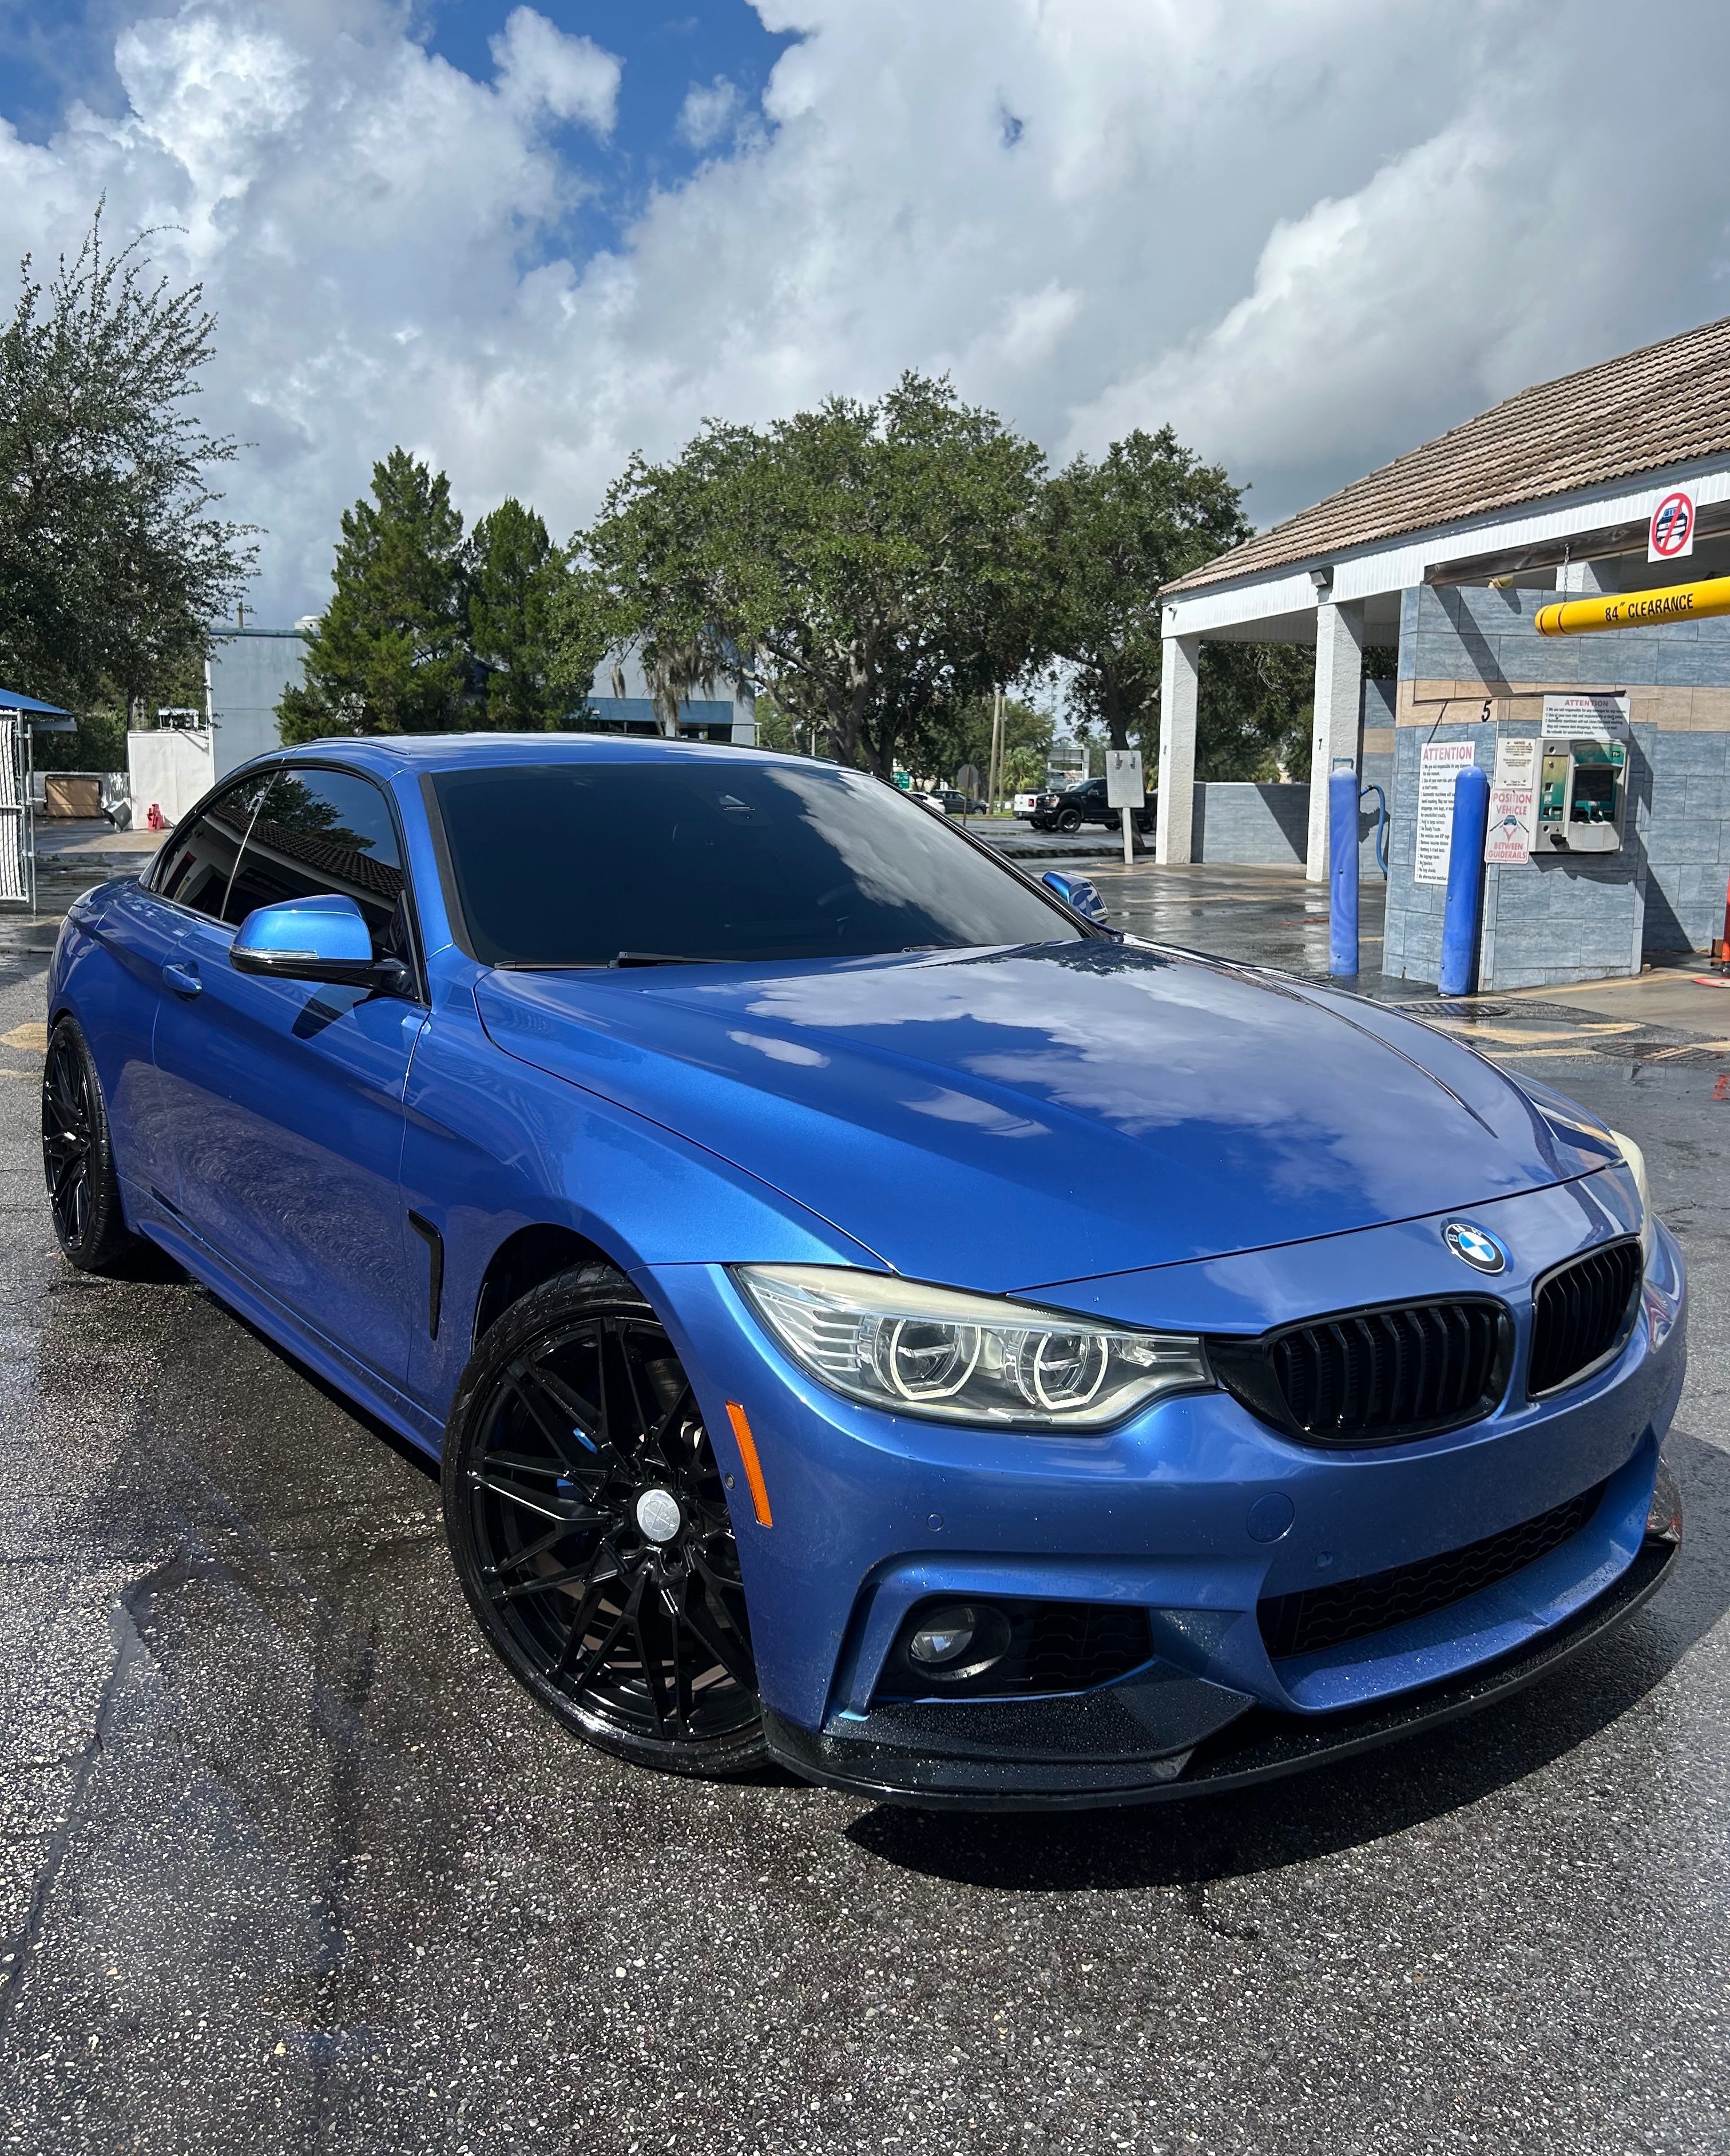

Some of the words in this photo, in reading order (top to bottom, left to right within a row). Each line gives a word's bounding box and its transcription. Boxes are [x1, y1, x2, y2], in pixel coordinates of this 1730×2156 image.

[1605, 601, 1625, 622] 84"
[1628, 593, 1693, 618] CLEARANCE
[1482, 700, 1492, 722] 5
[1423, 746, 1472, 760] ATTENTION
[1493, 793, 1531, 804] POSITION
[1496, 805, 1527, 815] VEHICLE
[1494, 842, 1523, 850] BETWEEN
[1489, 850, 1526, 858] GUIDERAILS
[1448, 1224, 1482, 1243] BMW
